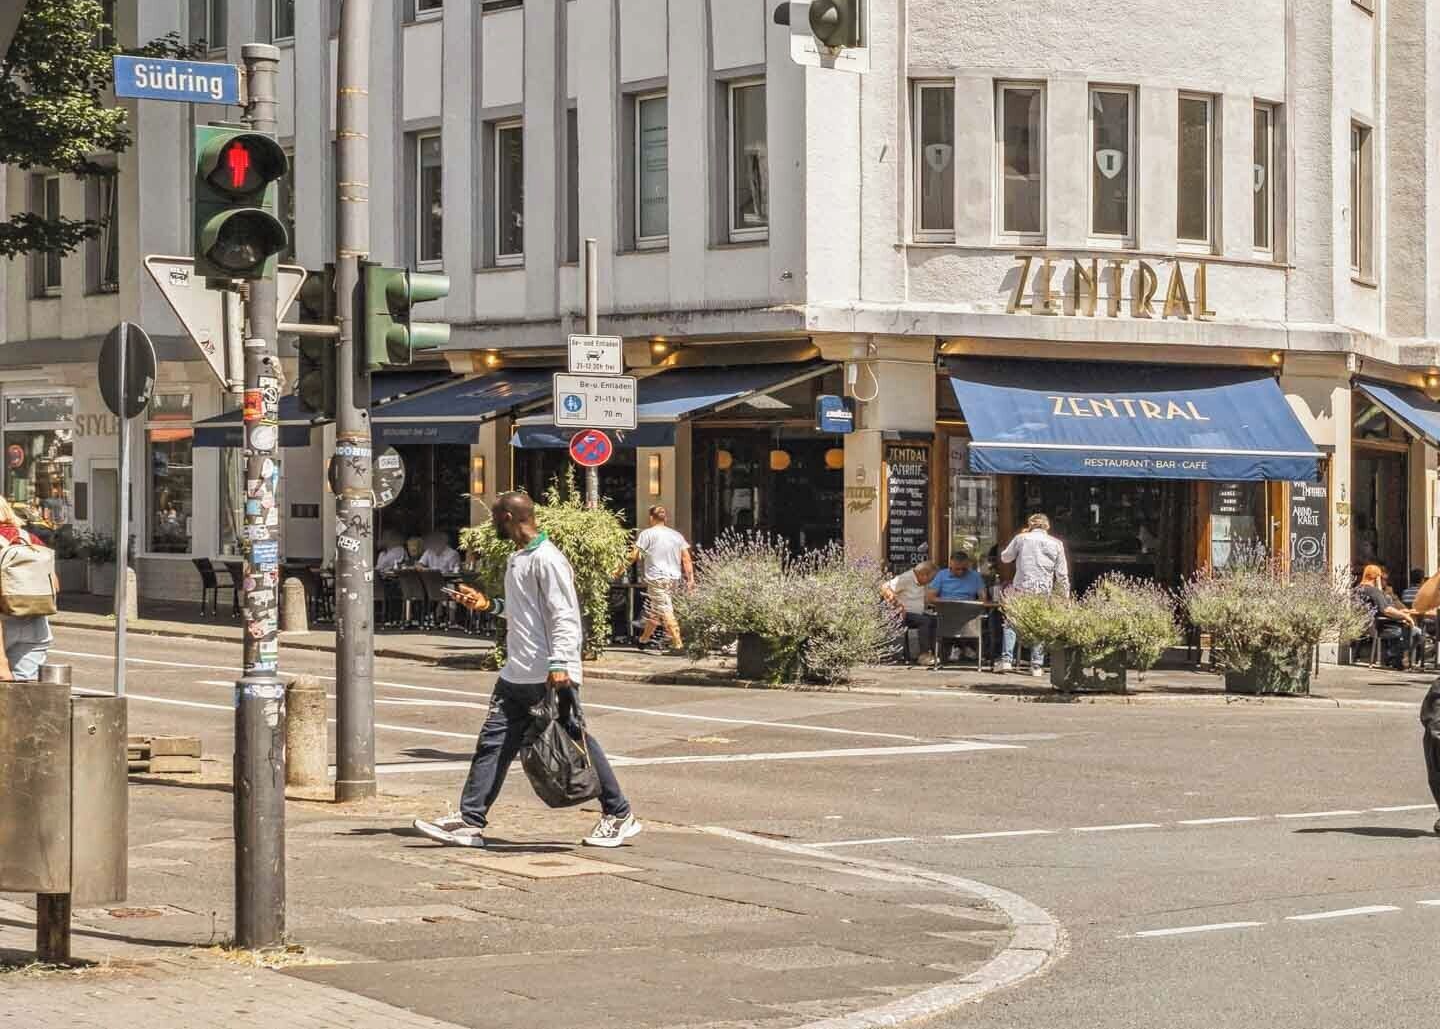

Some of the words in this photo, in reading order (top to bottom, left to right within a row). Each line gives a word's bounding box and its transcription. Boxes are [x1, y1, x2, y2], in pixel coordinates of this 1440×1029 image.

[135, 63, 223, 100] Südring
[1014, 255, 1217, 318] ZENTRAL
[1048, 396, 1211, 421] ZENTRAL
[1083, 458, 1150, 469] RESTAURANT
[1156, 460, 1176, 469] BAR
